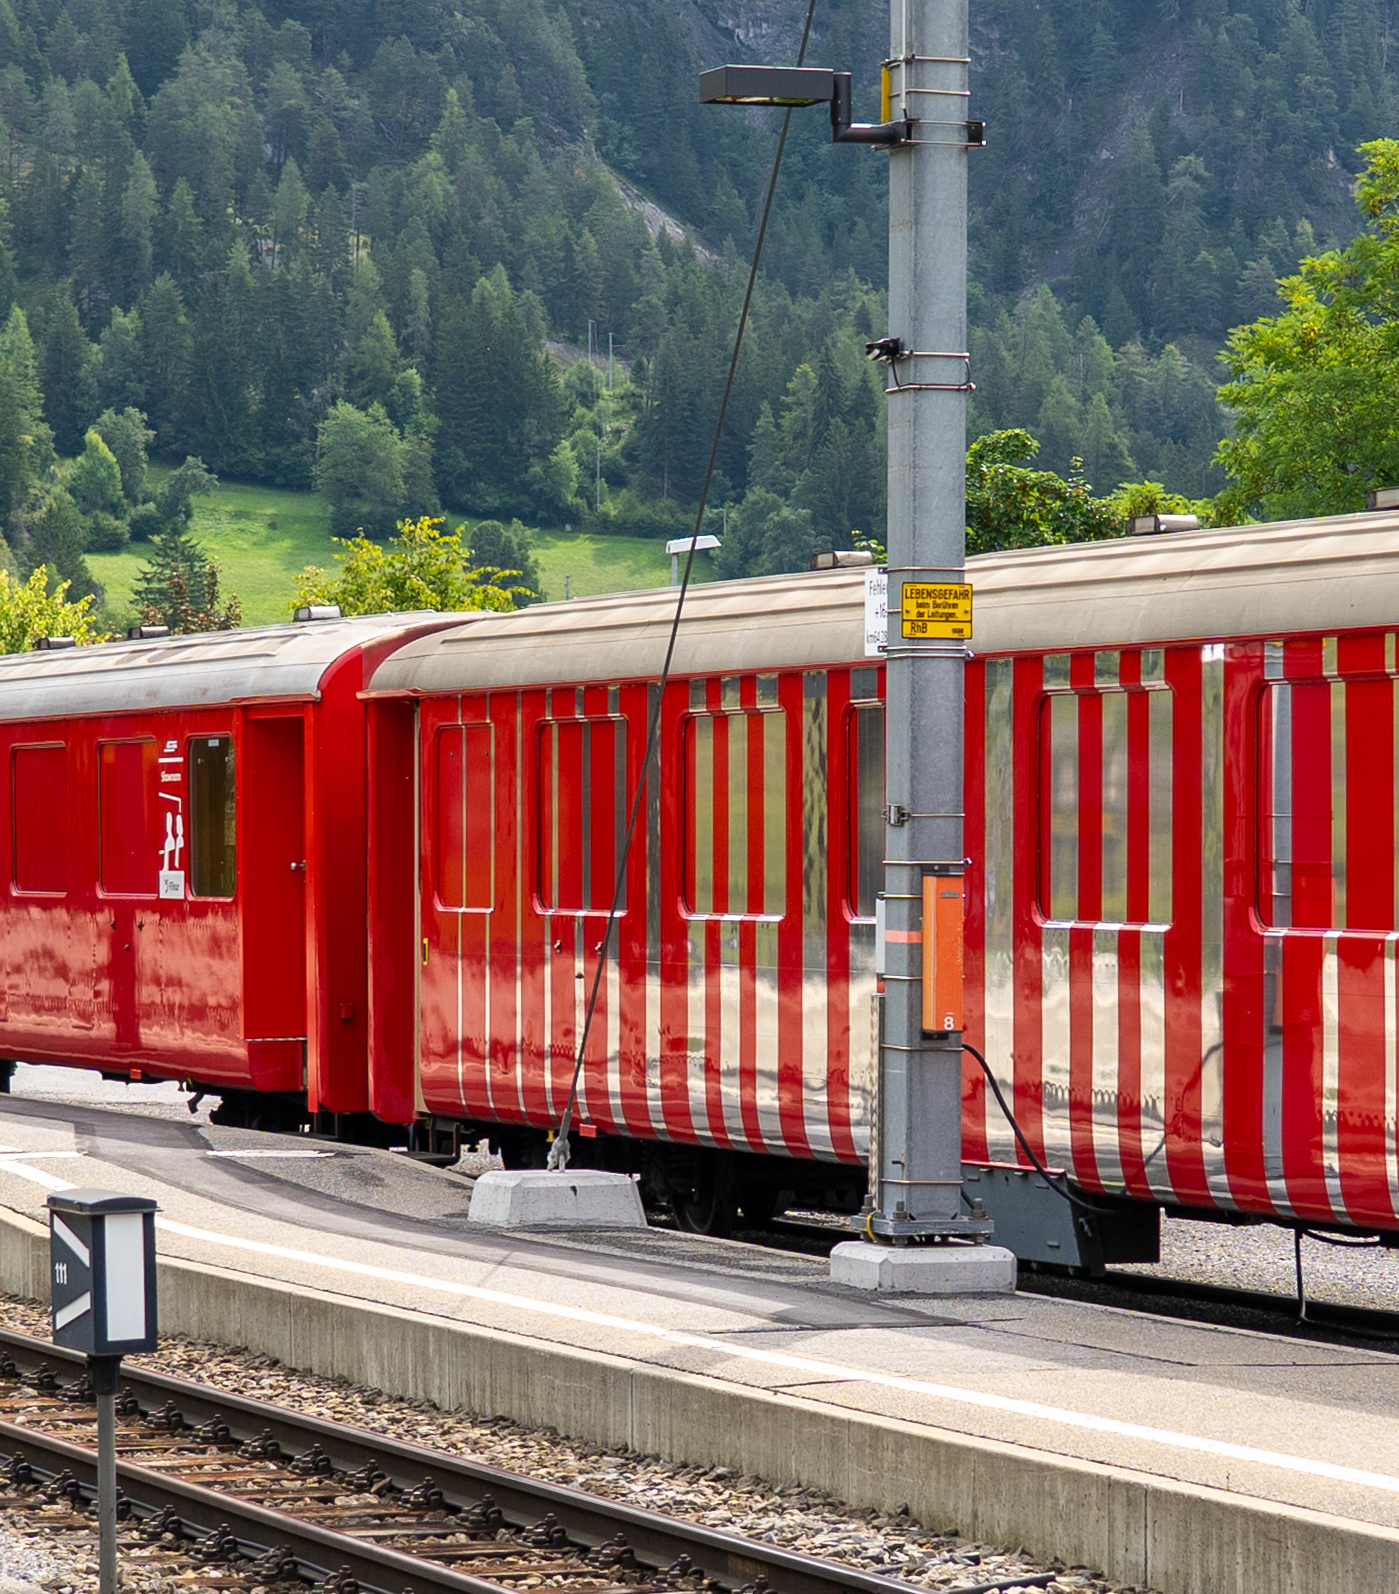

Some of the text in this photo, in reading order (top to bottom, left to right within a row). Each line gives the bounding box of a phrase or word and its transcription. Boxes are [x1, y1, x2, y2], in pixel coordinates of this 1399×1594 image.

[869, 579, 888, 596] Fehle
[905, 588, 970, 600] LEBENSGEFAHR
[916, 600, 930, 608] beim
[916, 610, 925, 618] der
[910, 622, 928, 633] RhB
[944, 1016, 954, 1030] 8
[55, 1262, 67, 1285] 111
